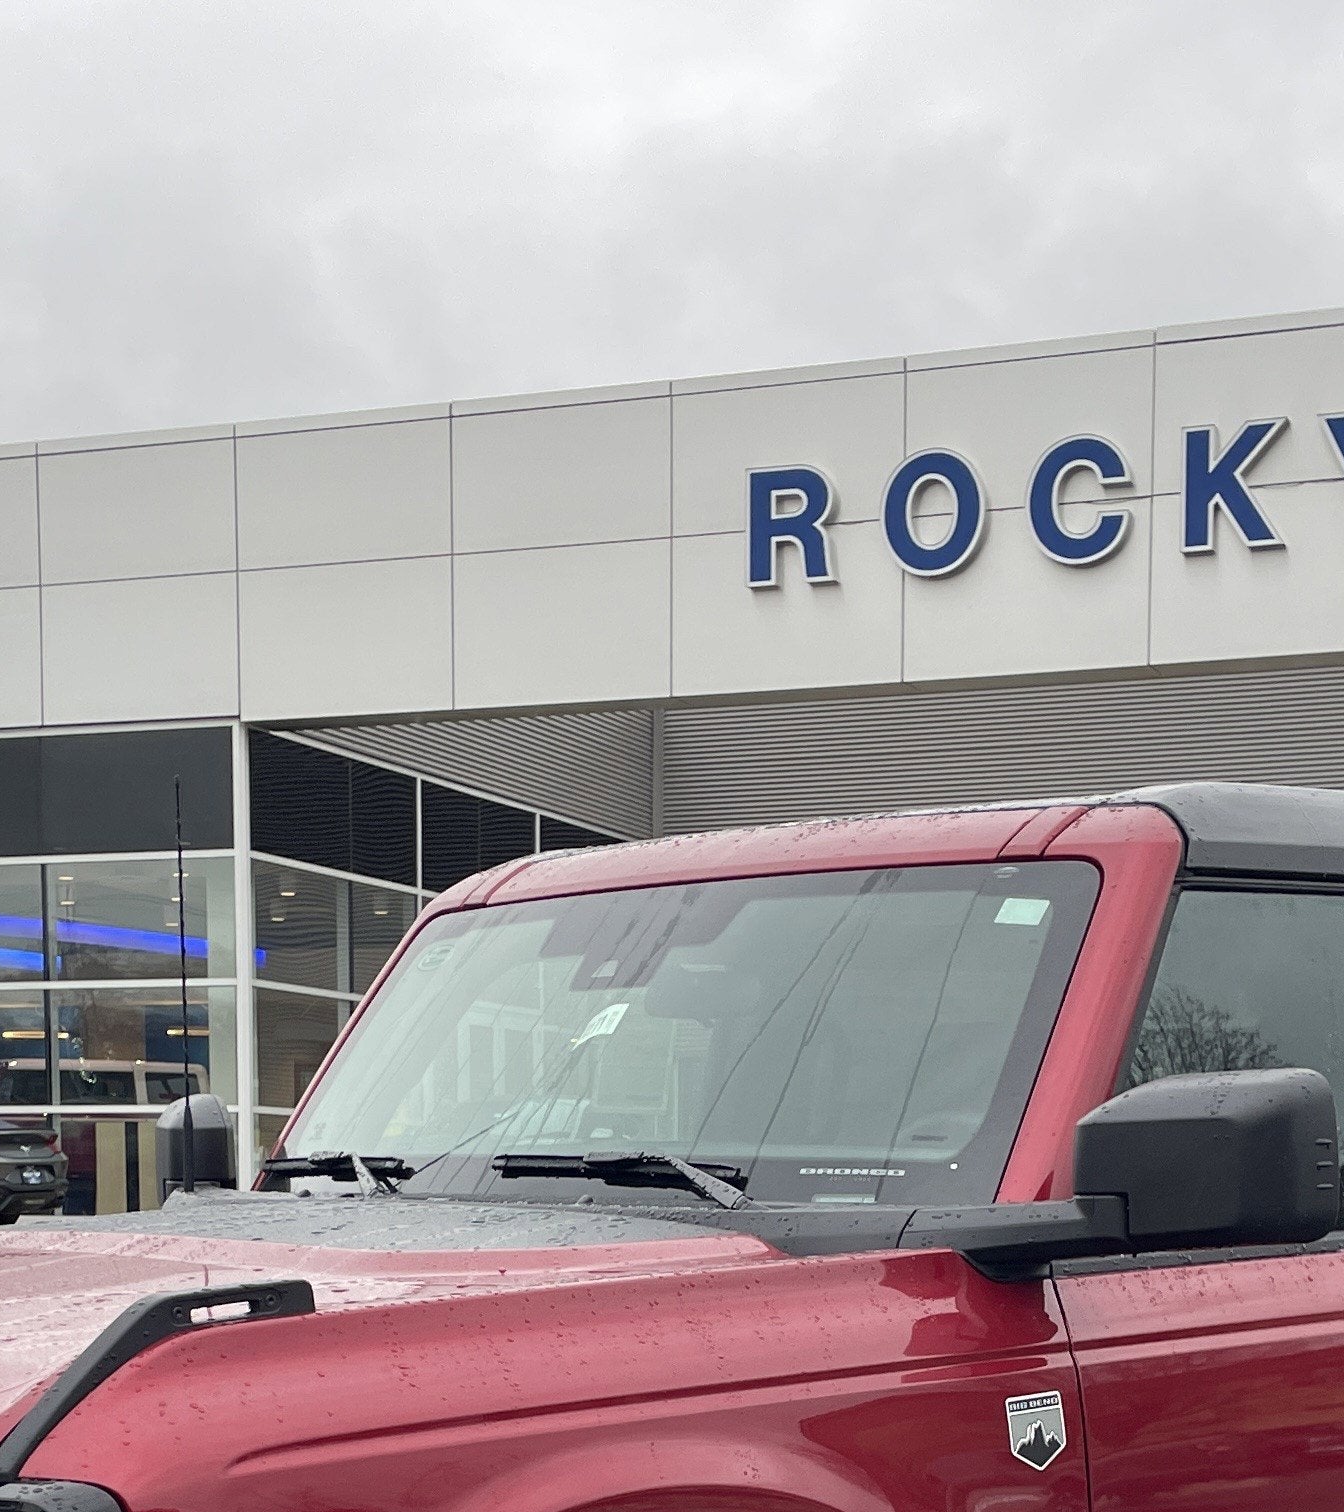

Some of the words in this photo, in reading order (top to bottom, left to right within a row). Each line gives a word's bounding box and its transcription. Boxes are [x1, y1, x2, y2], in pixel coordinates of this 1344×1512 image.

[799, 1167, 906, 1177] BRONCO
[1009, 1400, 1028, 1411] BIG
[1028, 1397, 1058, 1408] BEND
